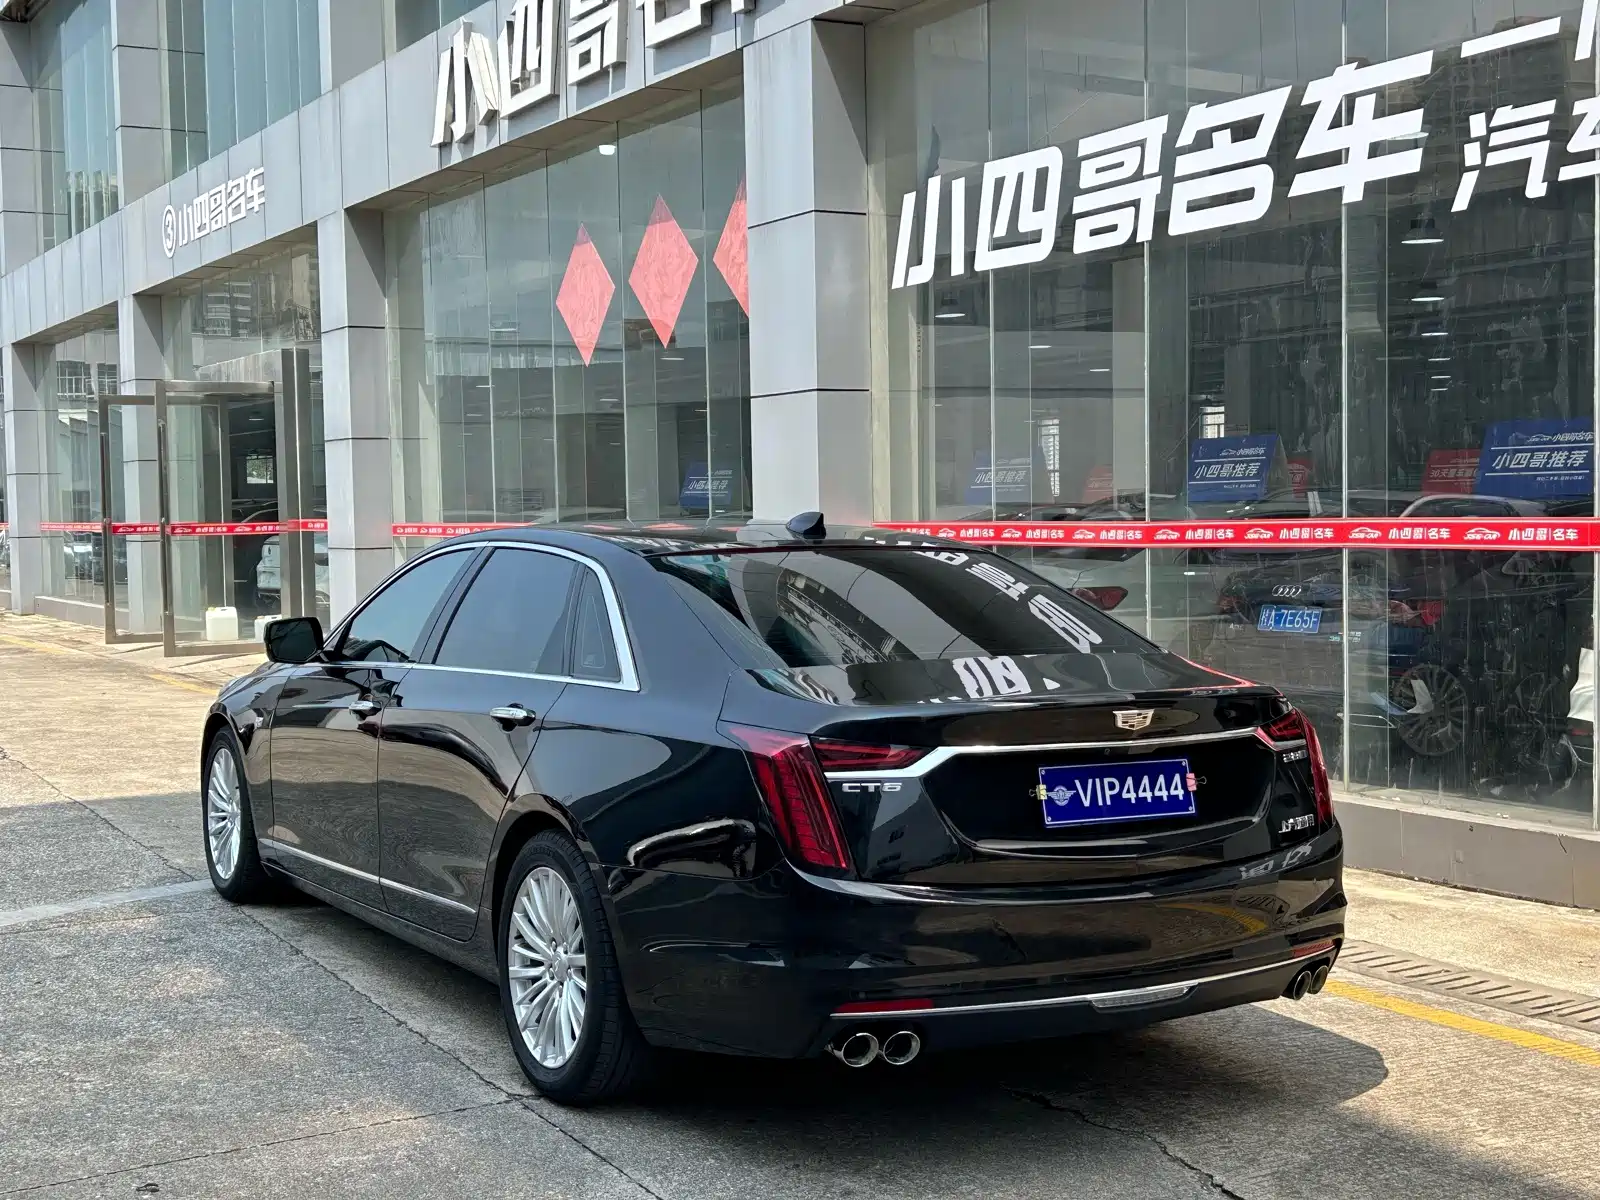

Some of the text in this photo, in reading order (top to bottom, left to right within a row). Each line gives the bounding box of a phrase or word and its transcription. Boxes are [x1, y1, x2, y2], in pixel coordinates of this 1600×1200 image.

[430, 0, 756, 147] 小四哥
[891, 50, 1434, 290] 小四哥名车
[1194, 462, 1261, 479] 小四哥推荐
[1492, 450, 1589, 469] 小四哥推荐
[842, 782, 902, 792] CT6
[1074, 773, 1185, 807] VIP4444
